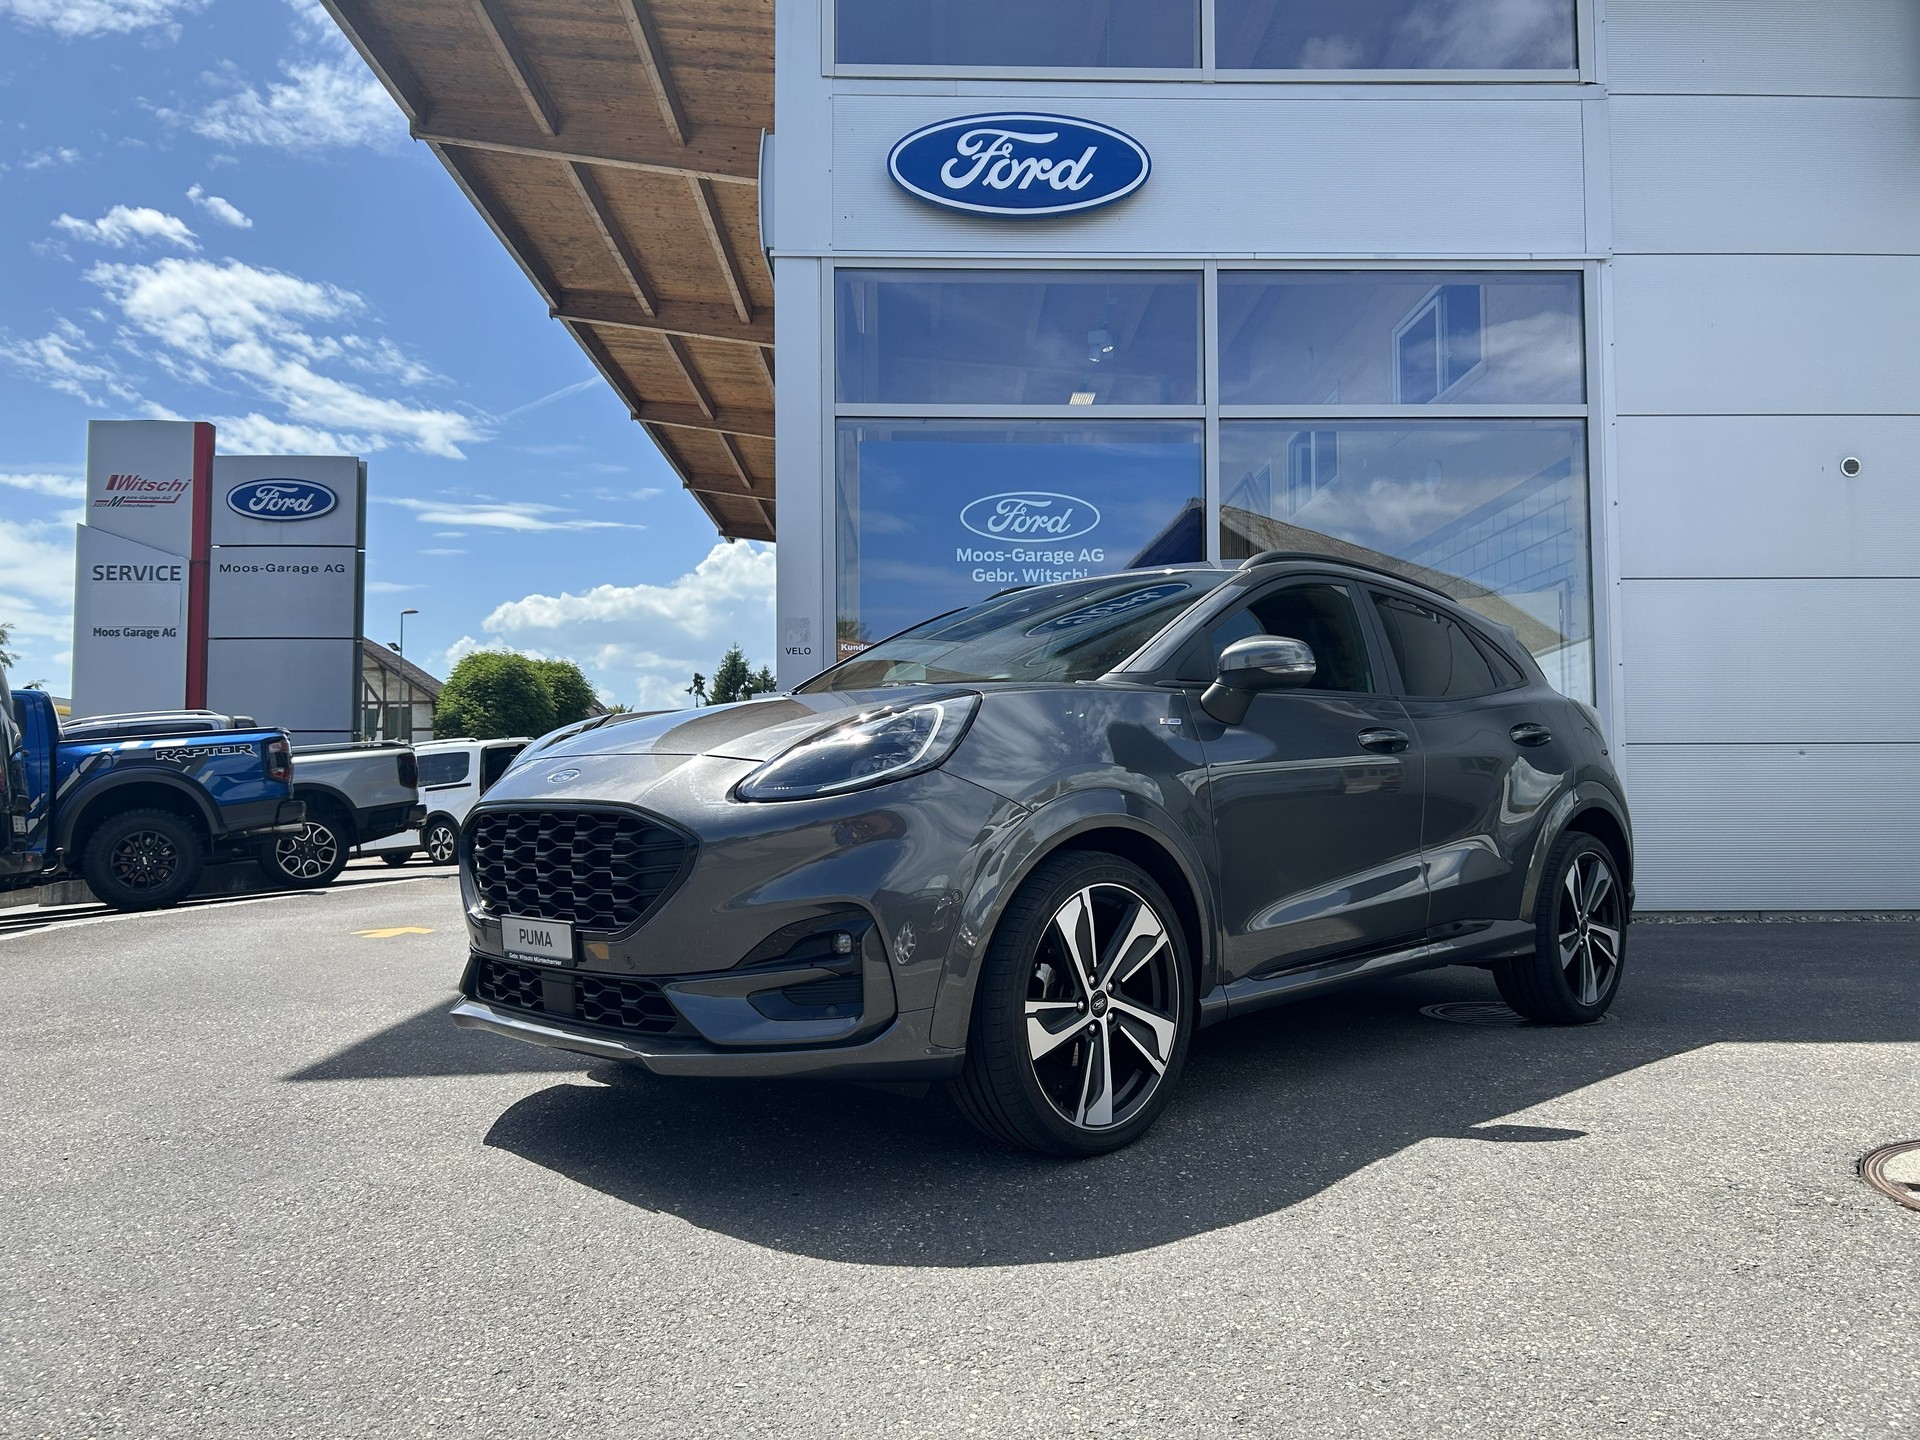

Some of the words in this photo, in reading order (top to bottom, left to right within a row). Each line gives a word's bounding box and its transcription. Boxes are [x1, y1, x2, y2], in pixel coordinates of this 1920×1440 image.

[940, 128, 1098, 191] Ford
[115, 474, 192, 492] Witschi
[248, 485, 315, 512] Ford
[987, 498, 1074, 534] Ford
[956, 548, 1074, 565] Moos-Garage
[1078, 548, 1105, 562] AG
[92, 564, 182, 582] SERVICE
[219, 563, 319, 575] Moos-Garage
[323, 563, 345, 574] AG
[972, 568, 1018, 582] Gebr.
[92, 627, 121, 637] Moos
[123, 627, 160, 640] Garage
[161, 627, 177, 638] AG
[785, 646, 812, 656] VELO
[155, 743, 259, 764] RAPTOR
[519, 928, 553, 947] PUMA
